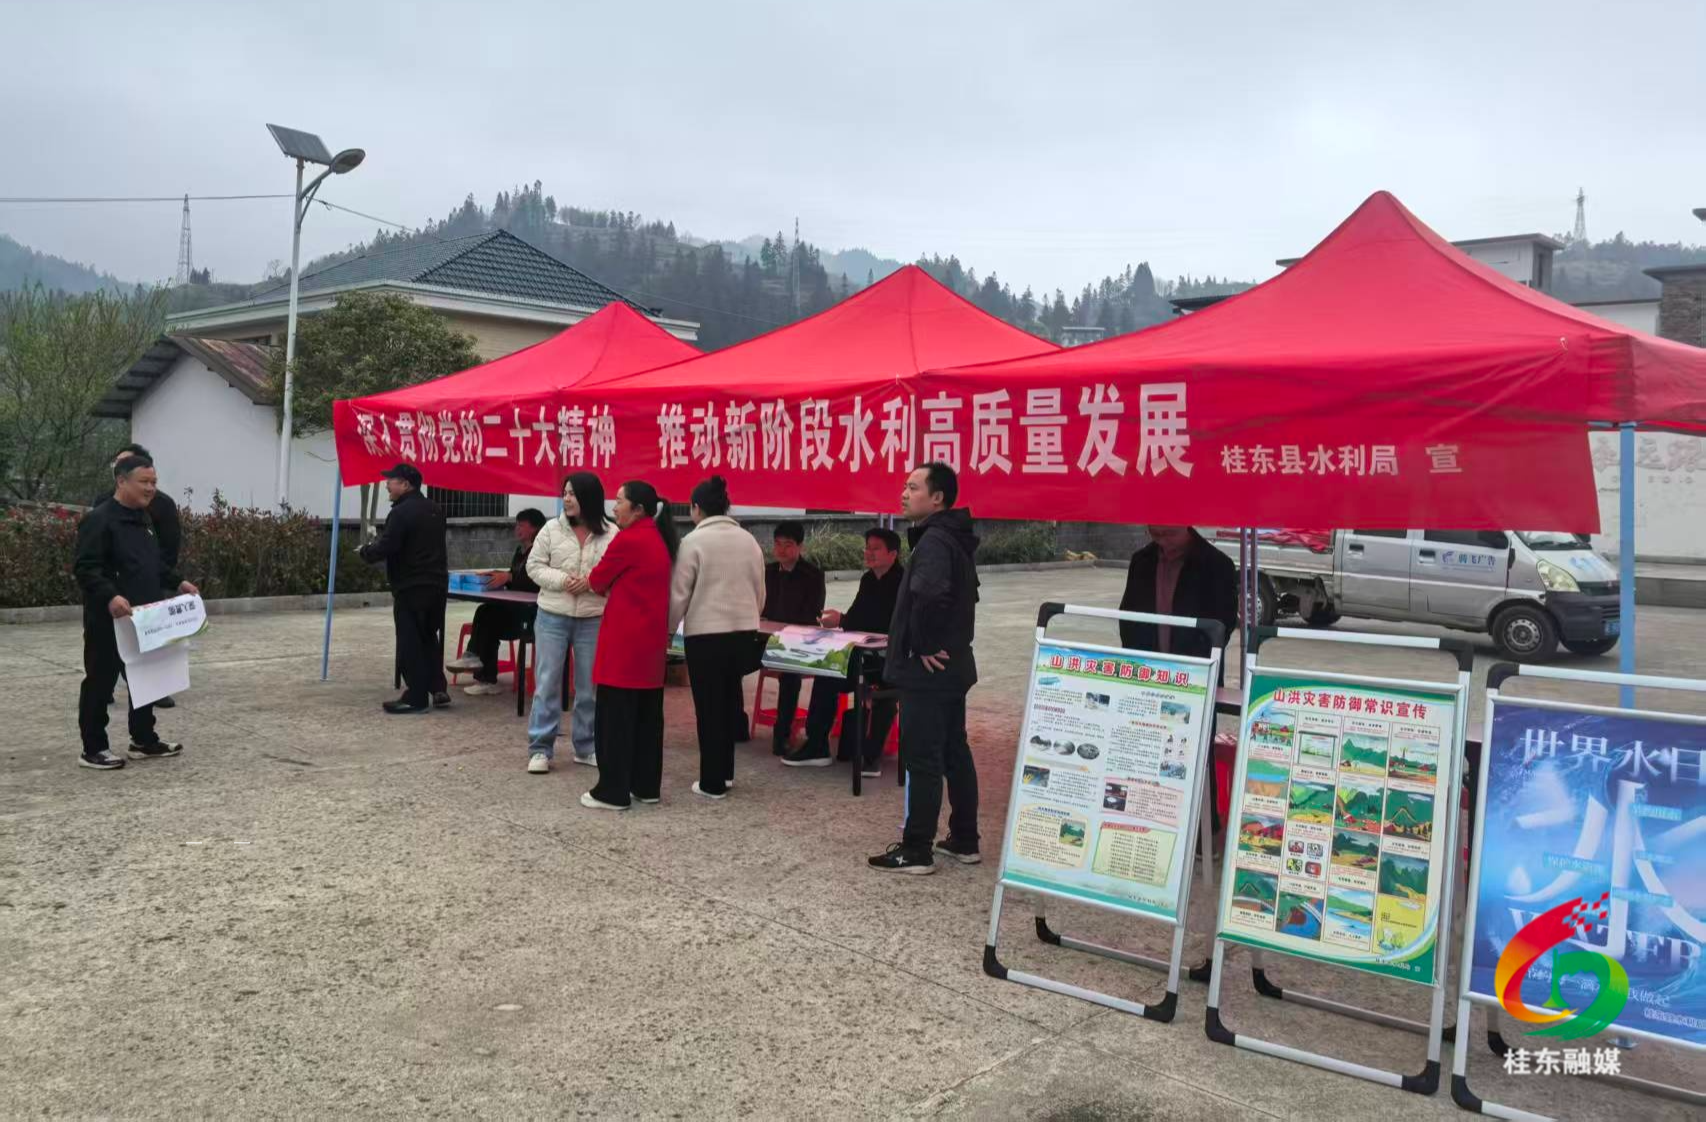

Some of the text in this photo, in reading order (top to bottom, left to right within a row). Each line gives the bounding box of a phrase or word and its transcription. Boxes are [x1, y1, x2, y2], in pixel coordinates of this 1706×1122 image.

[657, 381, 1195, 478] 推动新阶段水利高质量发展
[1220, 443, 1463, 476] 桂东县水利局 宣
[1050, 654, 1190, 687] 山洪灾害防御知识
[1272, 688, 1428, 720] 山洪灾害防御常识宣传
[1519, 728, 1706, 786] 世界水日
